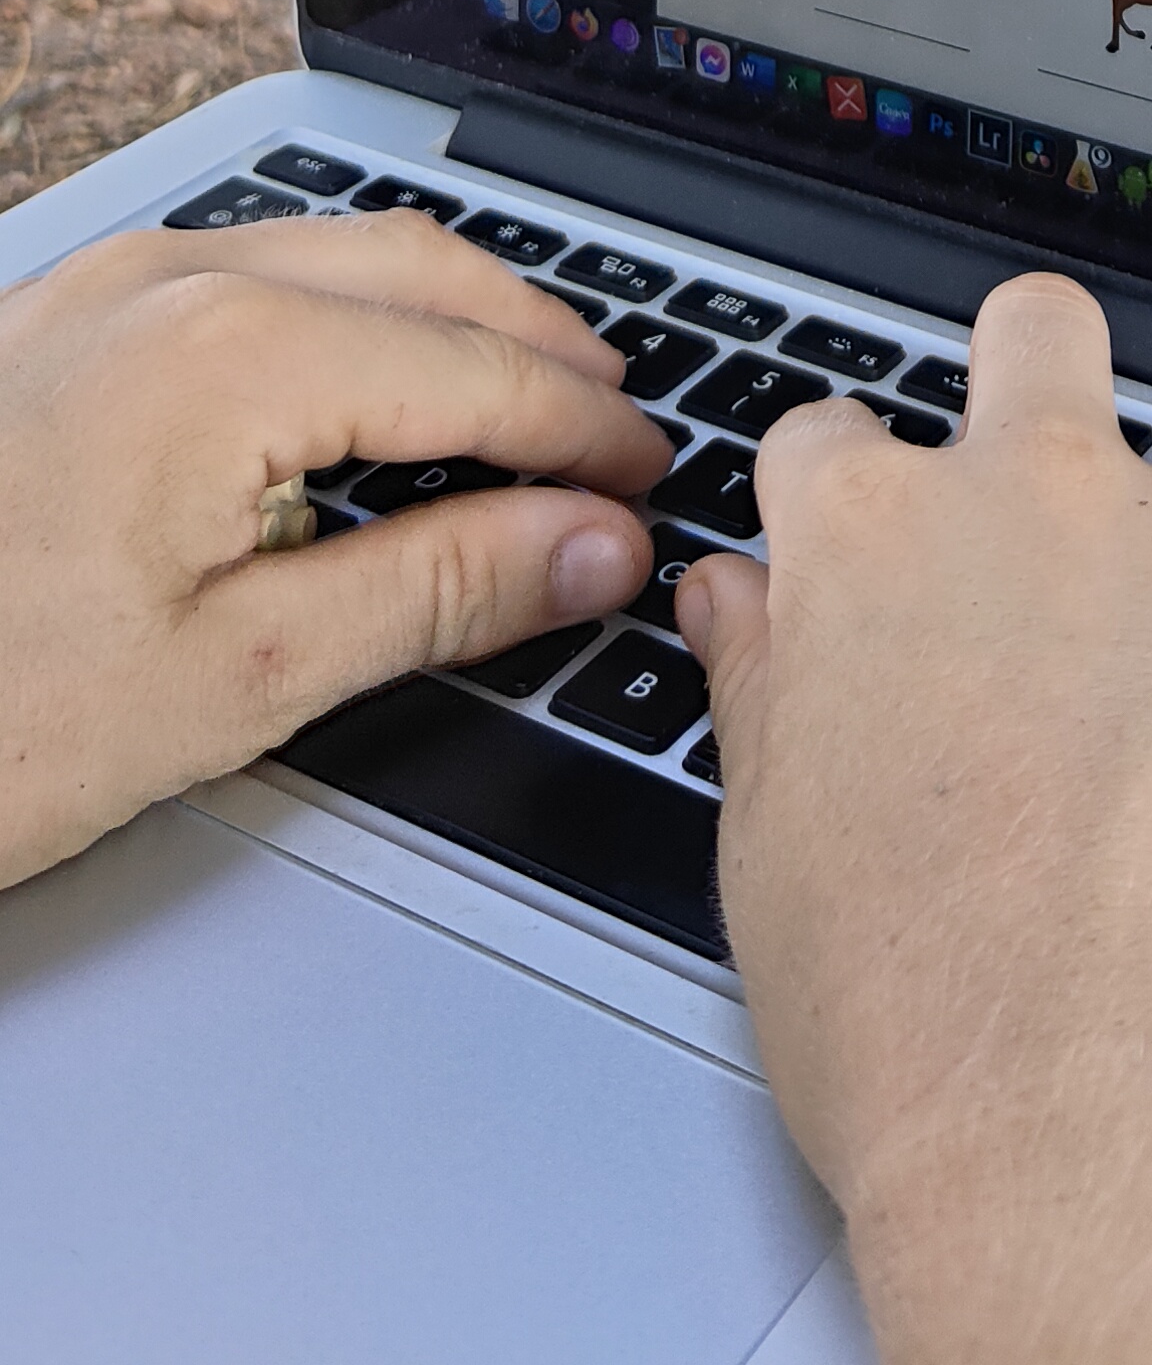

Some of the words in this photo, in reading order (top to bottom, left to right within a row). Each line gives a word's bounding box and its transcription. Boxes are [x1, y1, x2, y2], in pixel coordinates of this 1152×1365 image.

[929, 113, 954, 138] Ps
[978, 122, 1001, 151] Lr
[297, 158, 326, 172] esc
[630, 277, 647, 290] F3
[741, 315, 760, 327] F4
[642, 334, 666, 351] 4
[859, 355, 876, 366] F5
[752, 371, 780, 391] 5
[414, 467, 448, 489] D
[720, 472, 748, 494] T
[624, 671, 658, 698] B
